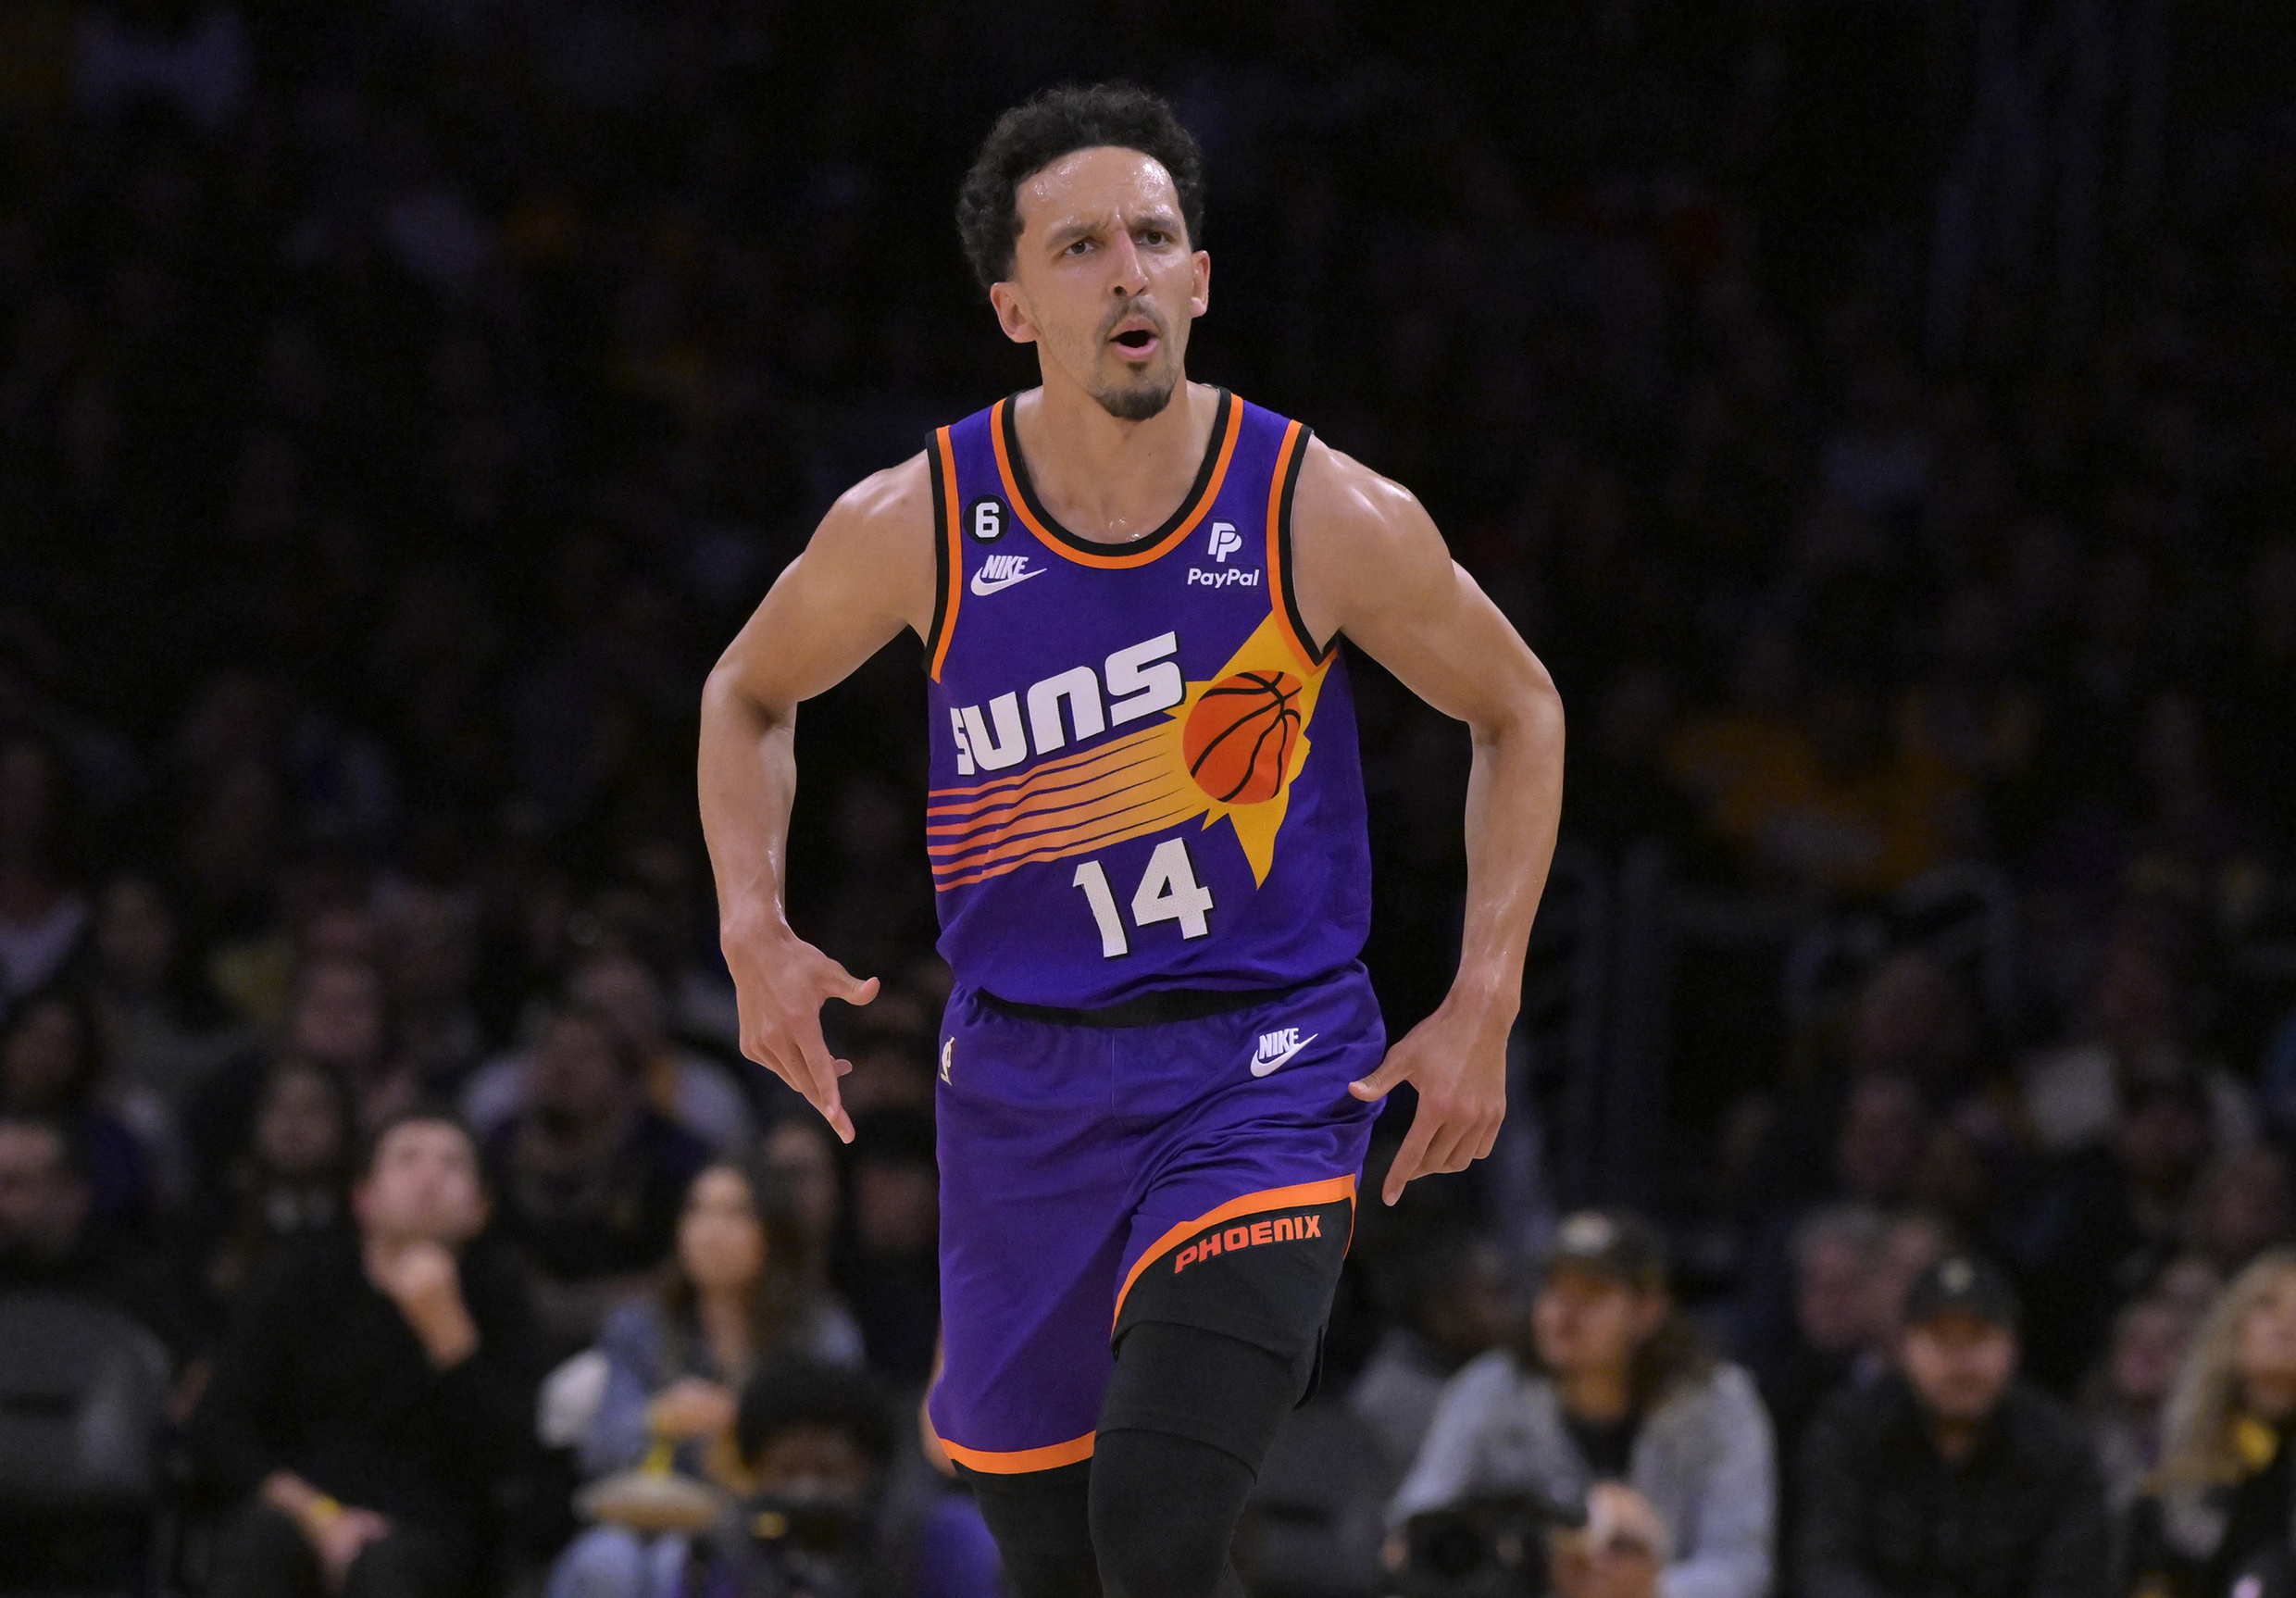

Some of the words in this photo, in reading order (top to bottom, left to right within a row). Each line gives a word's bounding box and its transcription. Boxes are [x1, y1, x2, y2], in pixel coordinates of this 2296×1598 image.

[975, 502, 1000, 538] 6
[980, 555, 1029, 580] NIKE
[1187, 568, 1260, 589] PayPal
[1072, 836, 1215, 958] 14
[1257, 1027, 1300, 1060] NIKE
